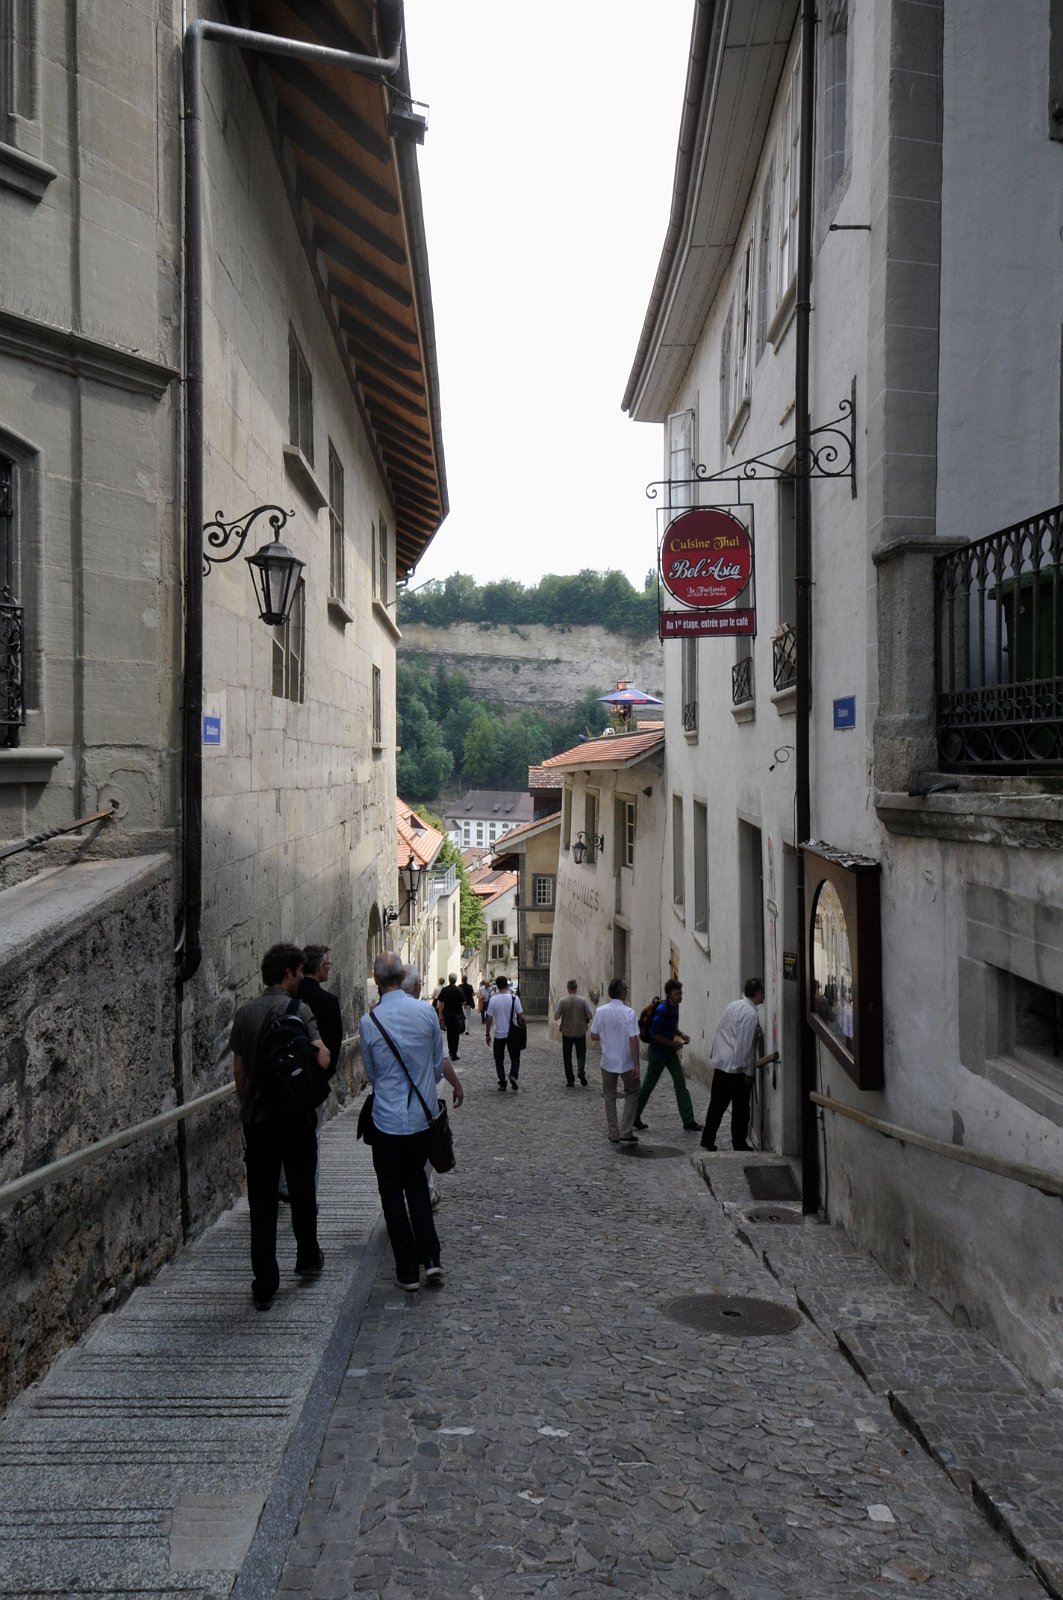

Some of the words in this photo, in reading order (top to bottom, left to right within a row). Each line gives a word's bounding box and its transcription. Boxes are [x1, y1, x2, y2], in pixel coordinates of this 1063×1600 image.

[670, 538, 710, 552] Cuisine
[713, 536, 740, 550] Thai
[669, 557, 743, 581] Bel'Asia
[729, 617, 736, 627] le
[736, 616, 749, 626] café
